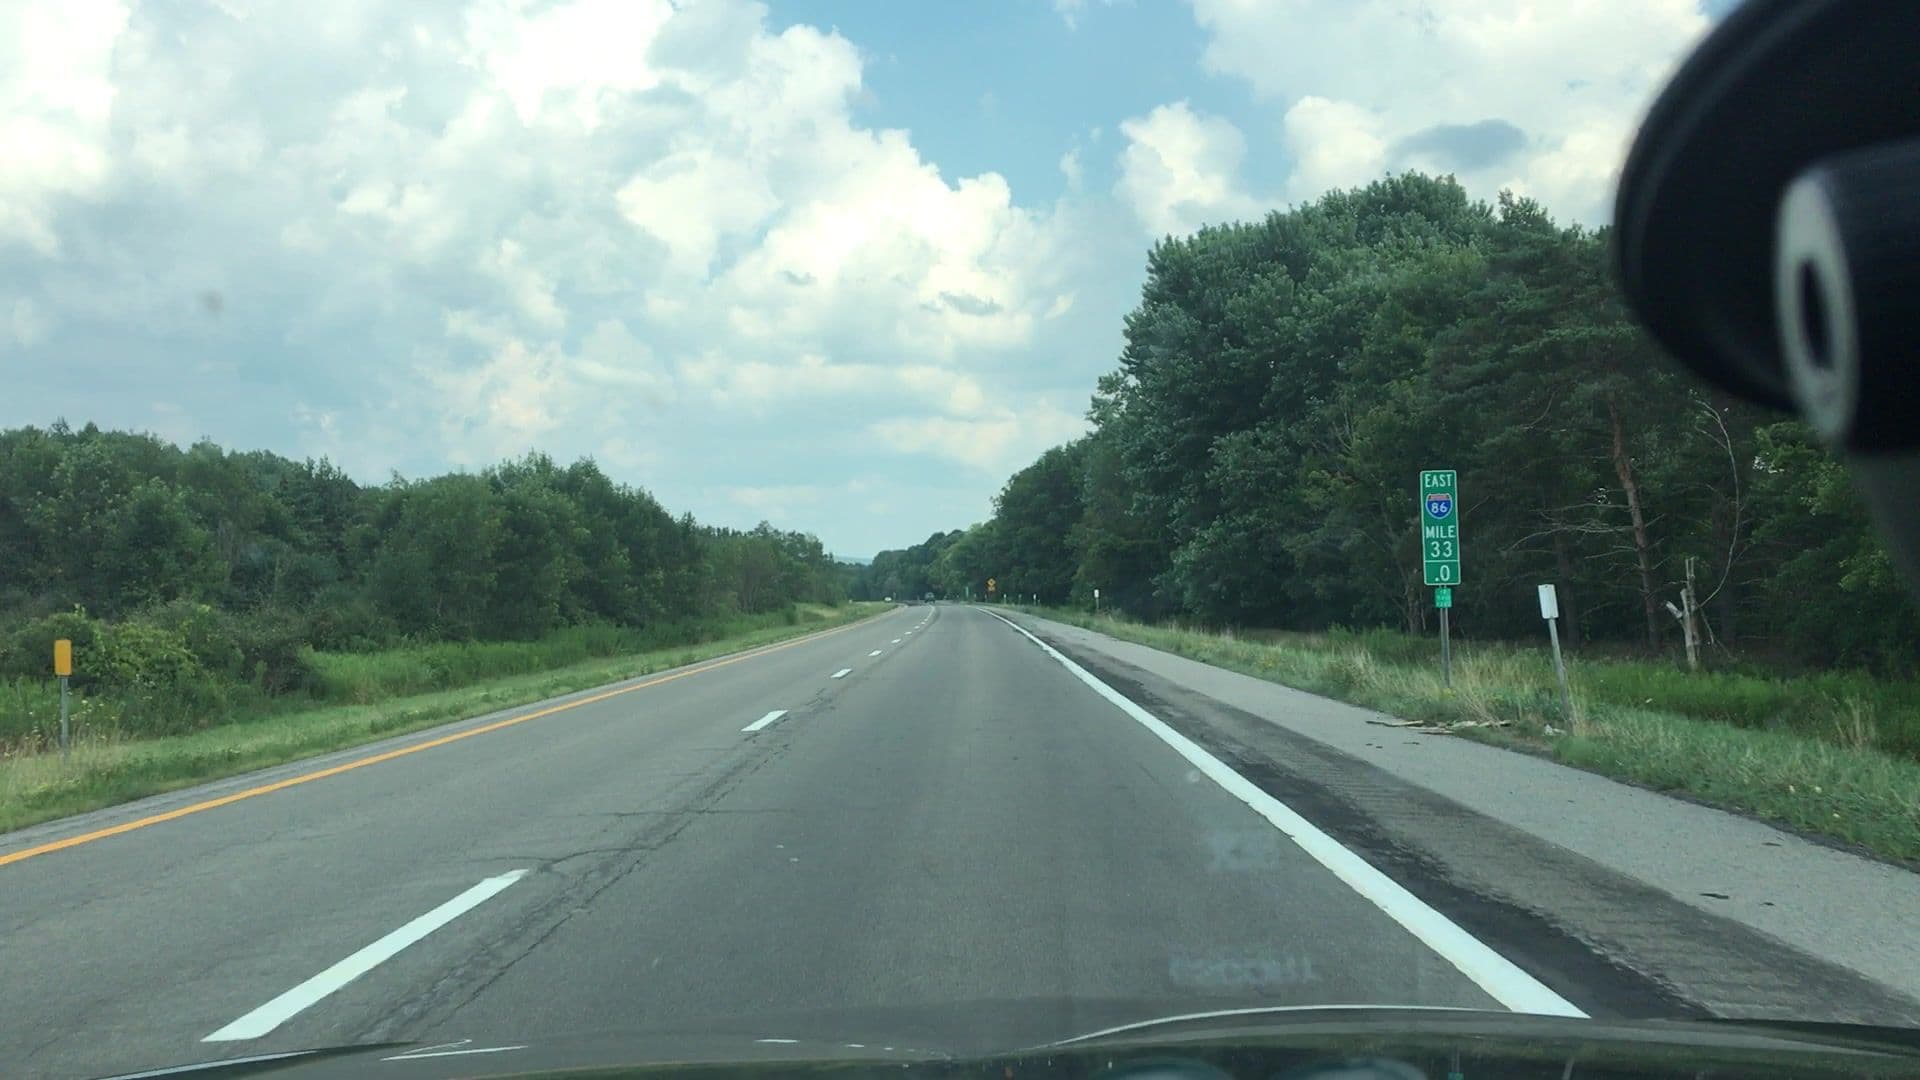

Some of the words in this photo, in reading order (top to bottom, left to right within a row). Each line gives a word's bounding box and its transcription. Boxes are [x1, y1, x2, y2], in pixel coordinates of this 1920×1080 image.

[1425, 474, 1452, 488] EAST
[1431, 502, 1448, 514] 86
[1426, 525, 1456, 539] MILE
[1431, 541, 1452, 558] 33
